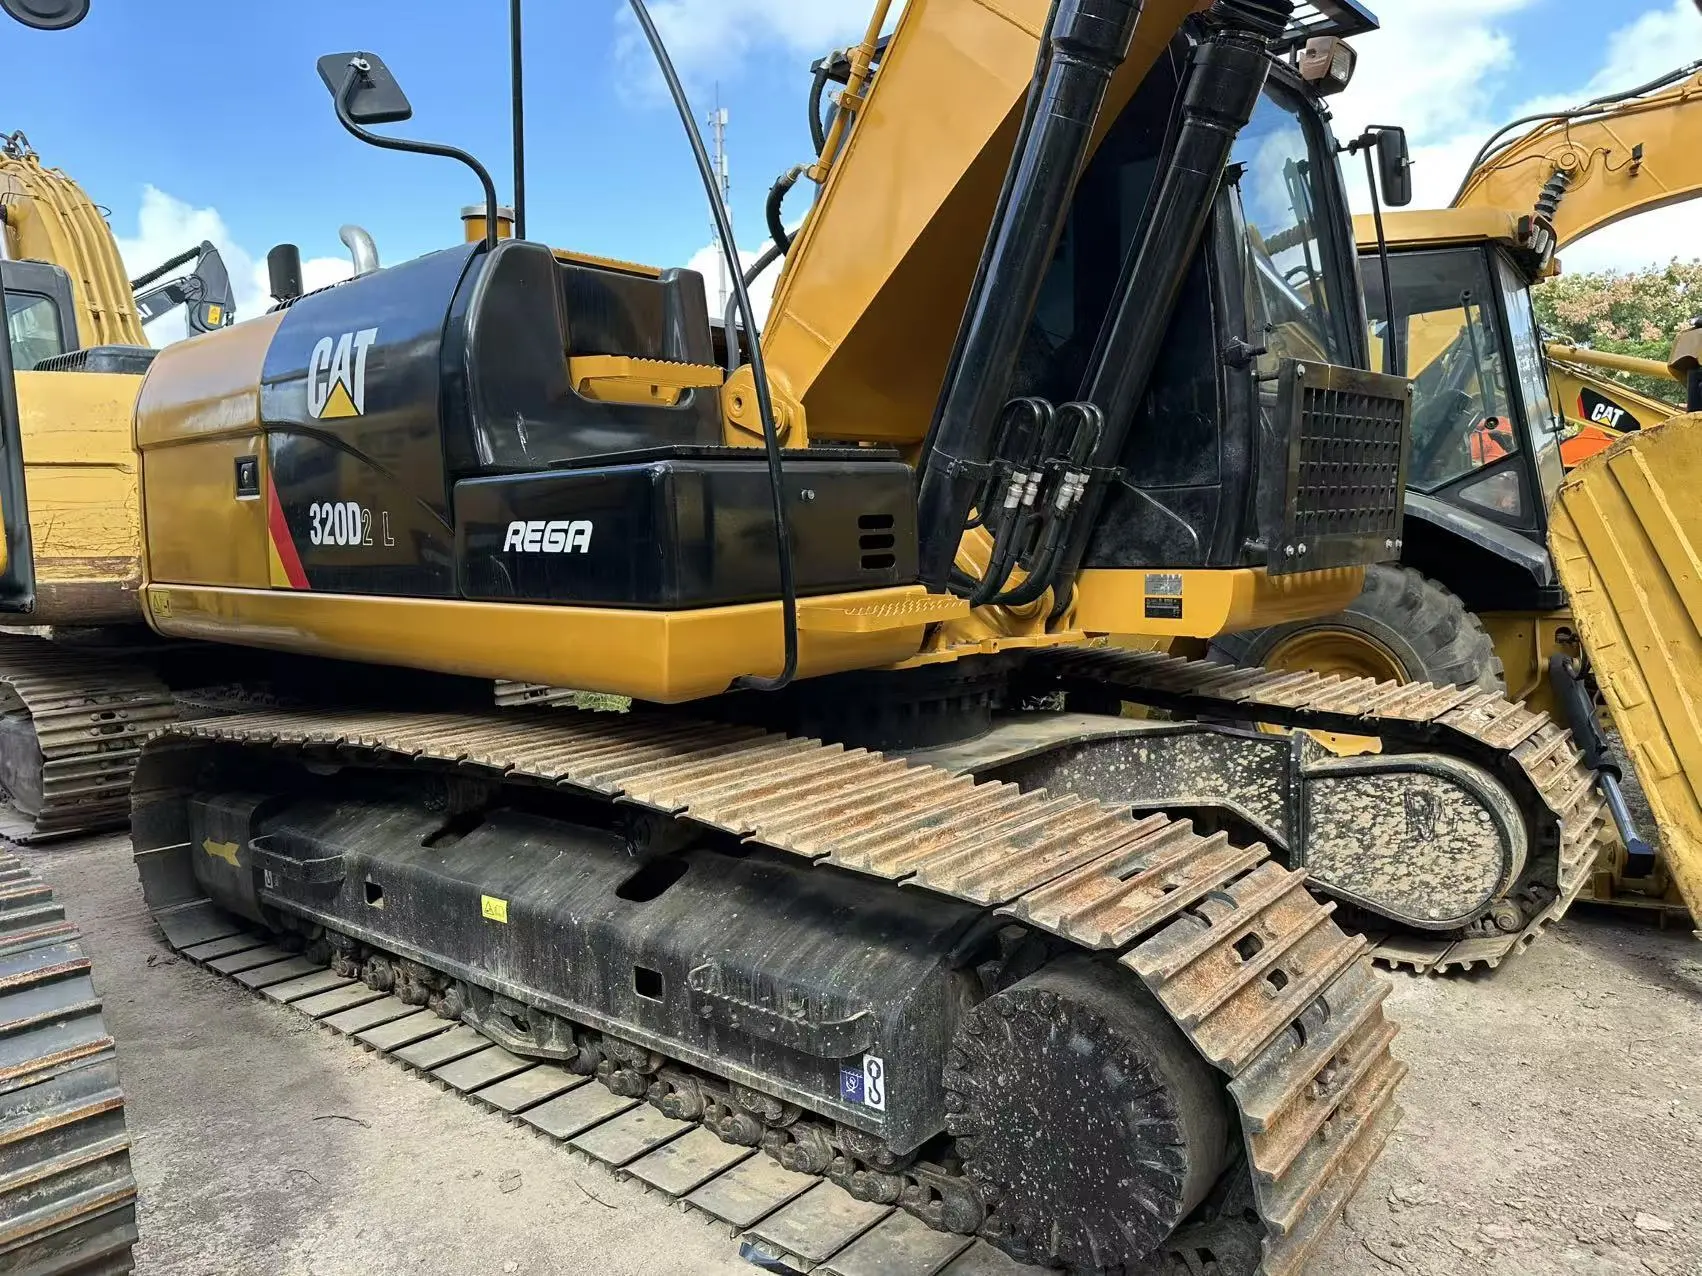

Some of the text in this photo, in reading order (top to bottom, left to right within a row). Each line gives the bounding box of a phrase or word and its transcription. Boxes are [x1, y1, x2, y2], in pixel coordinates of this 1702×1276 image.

[308, 328, 378, 418] CAT
[1591, 403, 1624, 428] CAT
[503, 520, 593, 553] REGA
